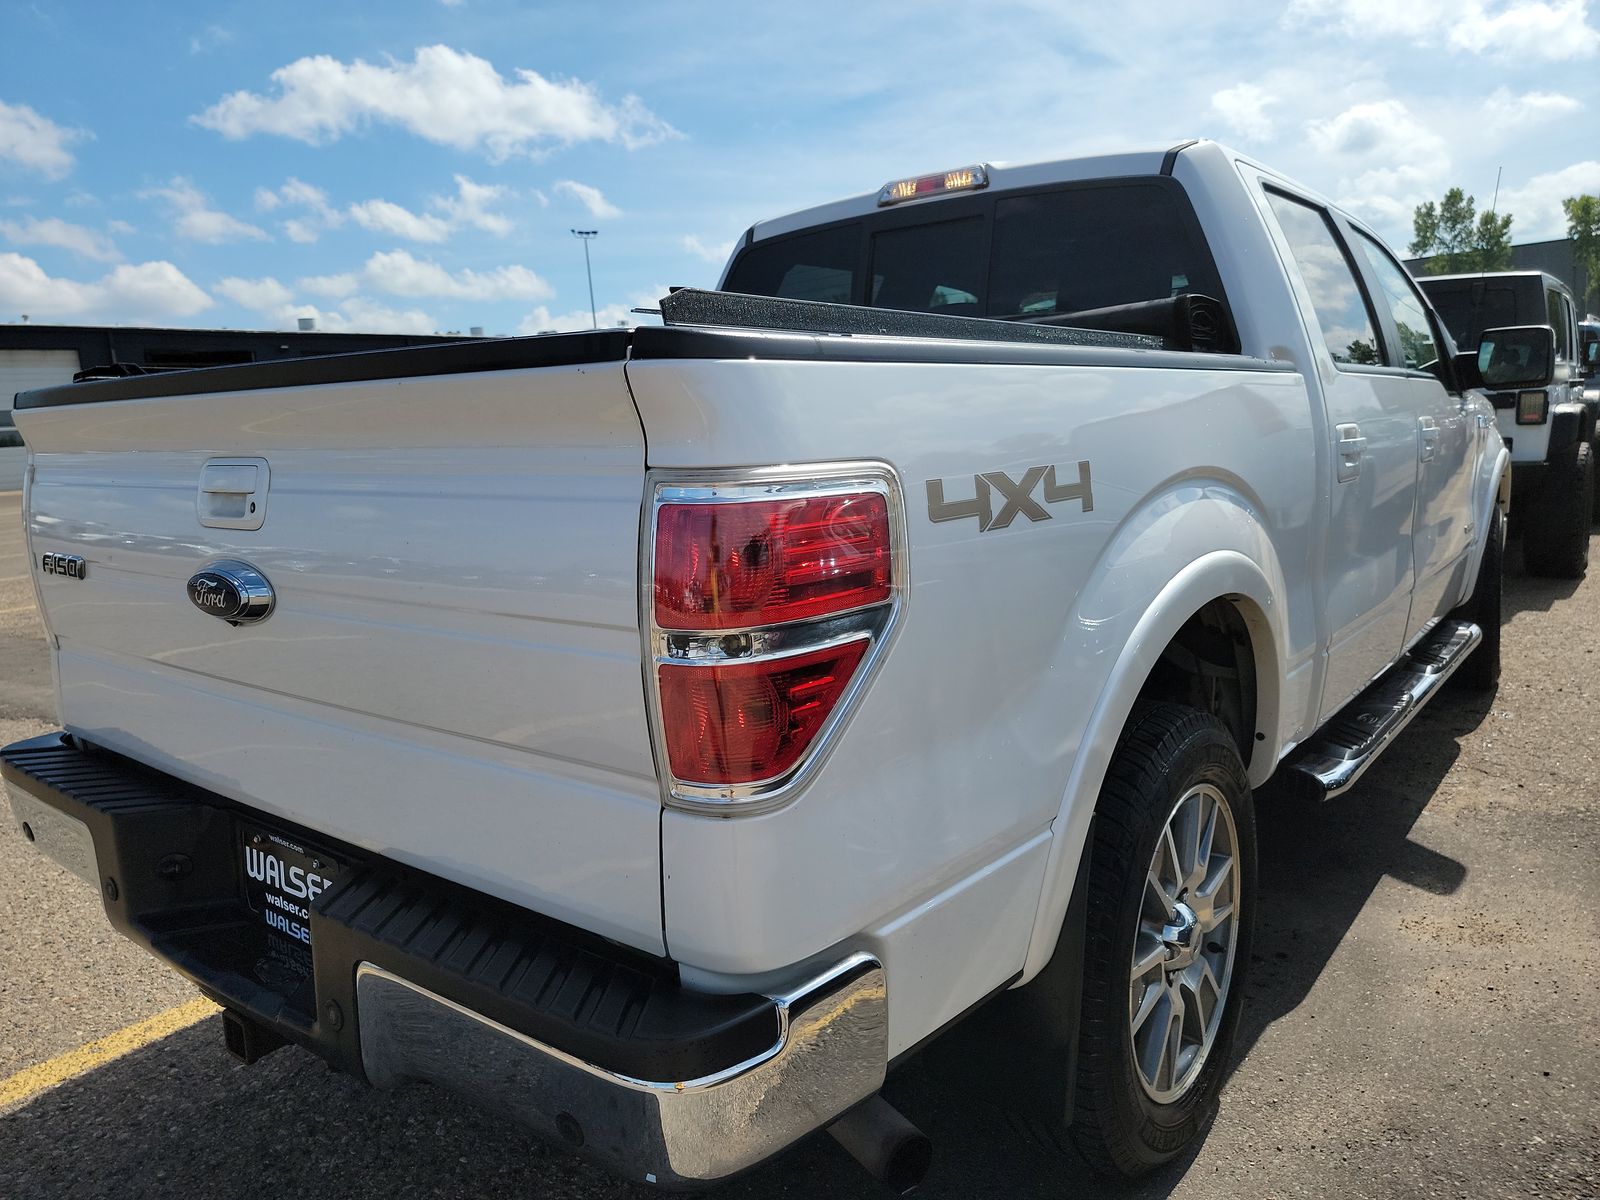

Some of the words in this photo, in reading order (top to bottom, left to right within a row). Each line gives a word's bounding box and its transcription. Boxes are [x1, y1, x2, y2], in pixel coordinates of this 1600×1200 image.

[926, 461, 1093, 533] 4X4
[192, 578, 227, 608] Ford
[265, 892, 309, 919] walser.c
[265, 908, 312, 945] WALSE
